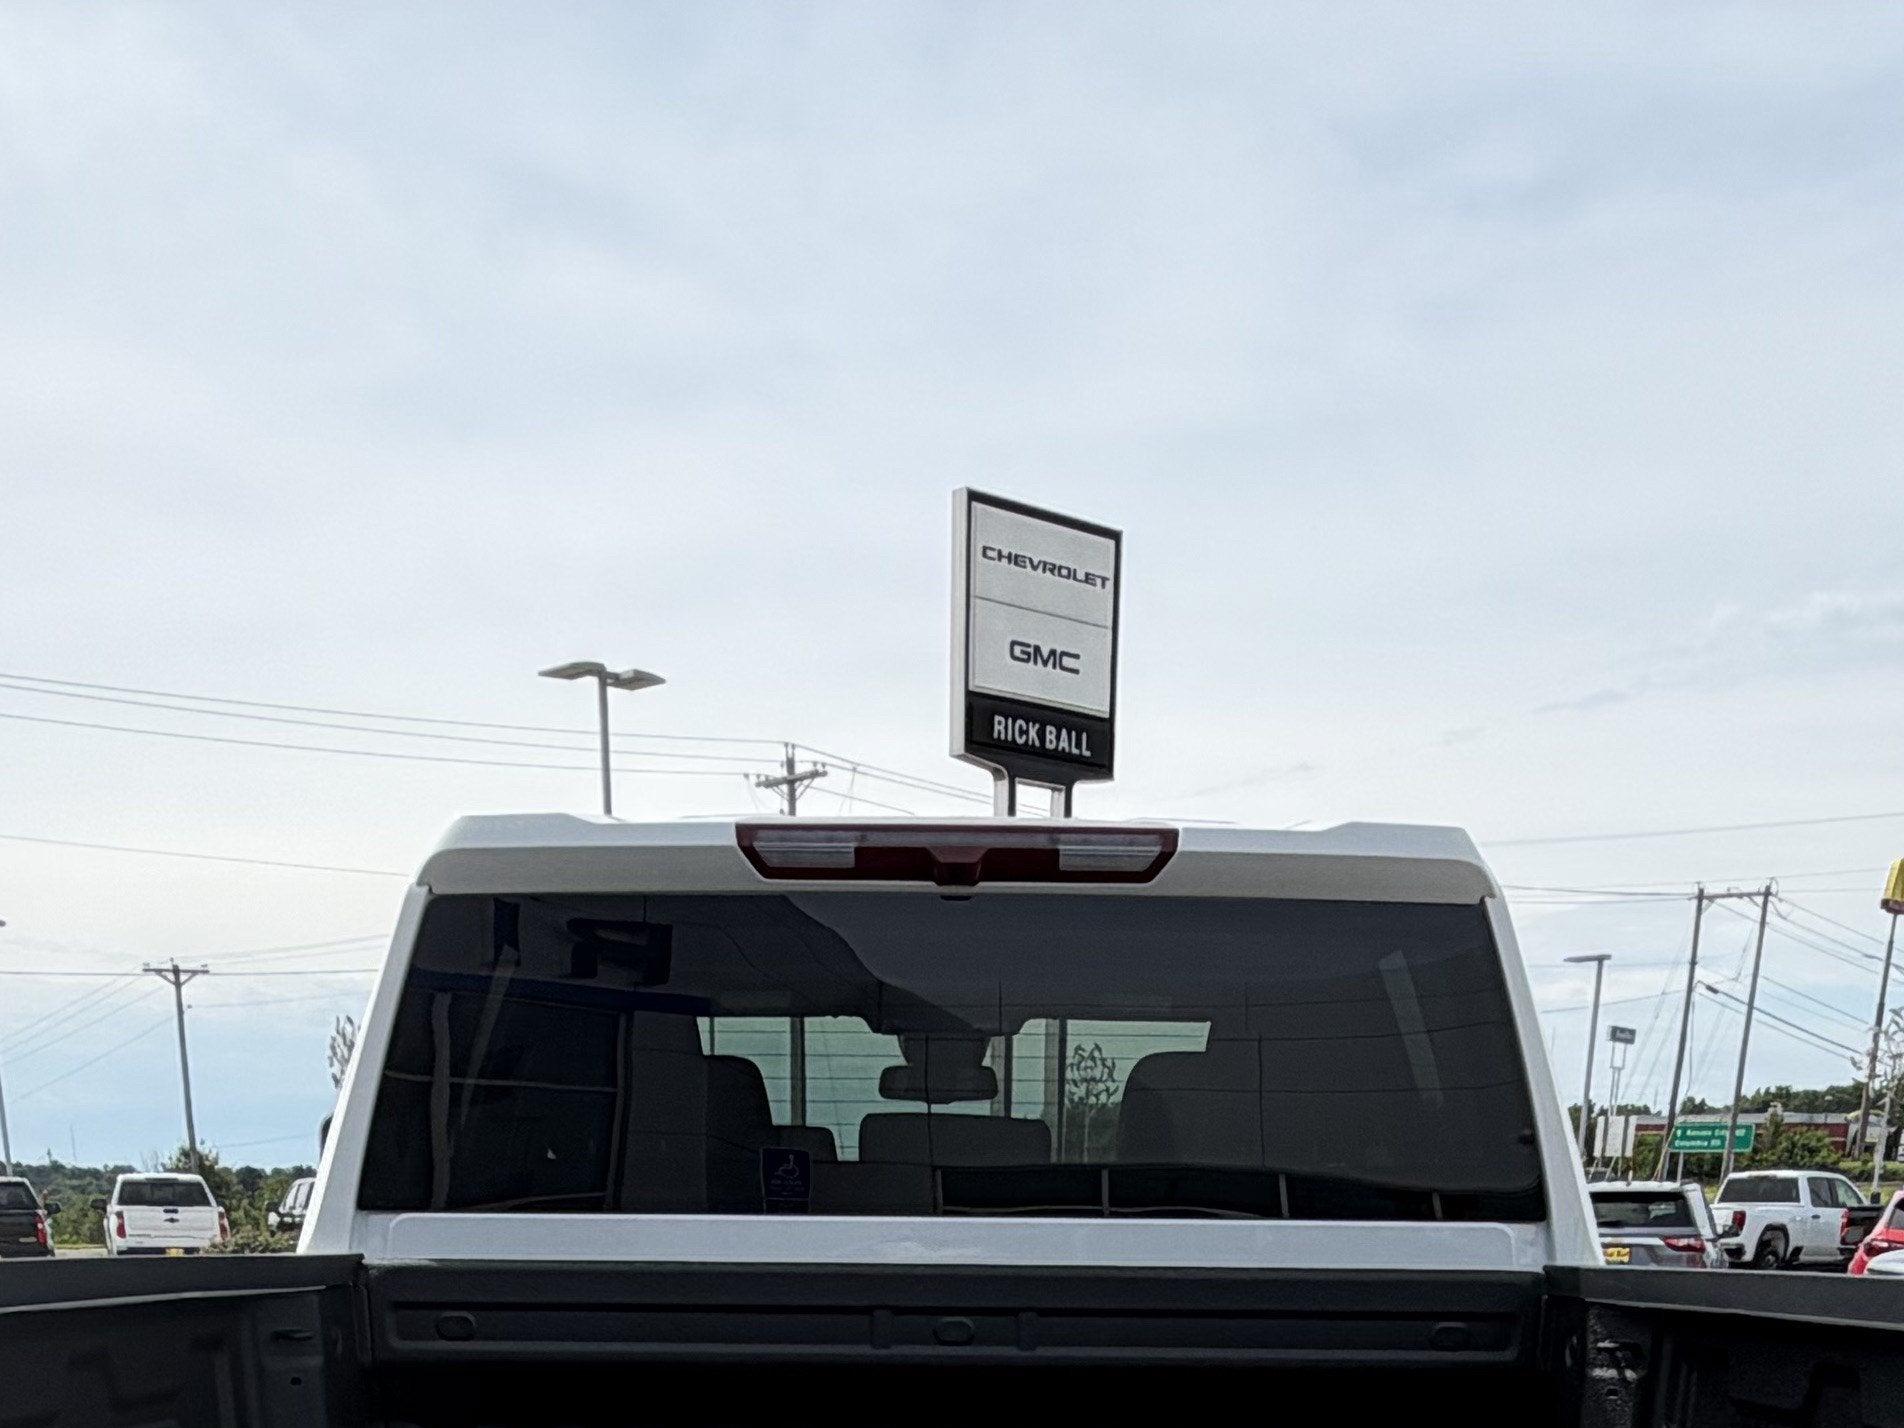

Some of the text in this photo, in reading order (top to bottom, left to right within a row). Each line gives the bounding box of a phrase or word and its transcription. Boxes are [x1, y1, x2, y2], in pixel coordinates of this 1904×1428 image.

[982, 545, 1110, 589] CHEVROLET
[1009, 640, 1081, 675] GMC
[993, 714, 1091, 757] RICK BALL
